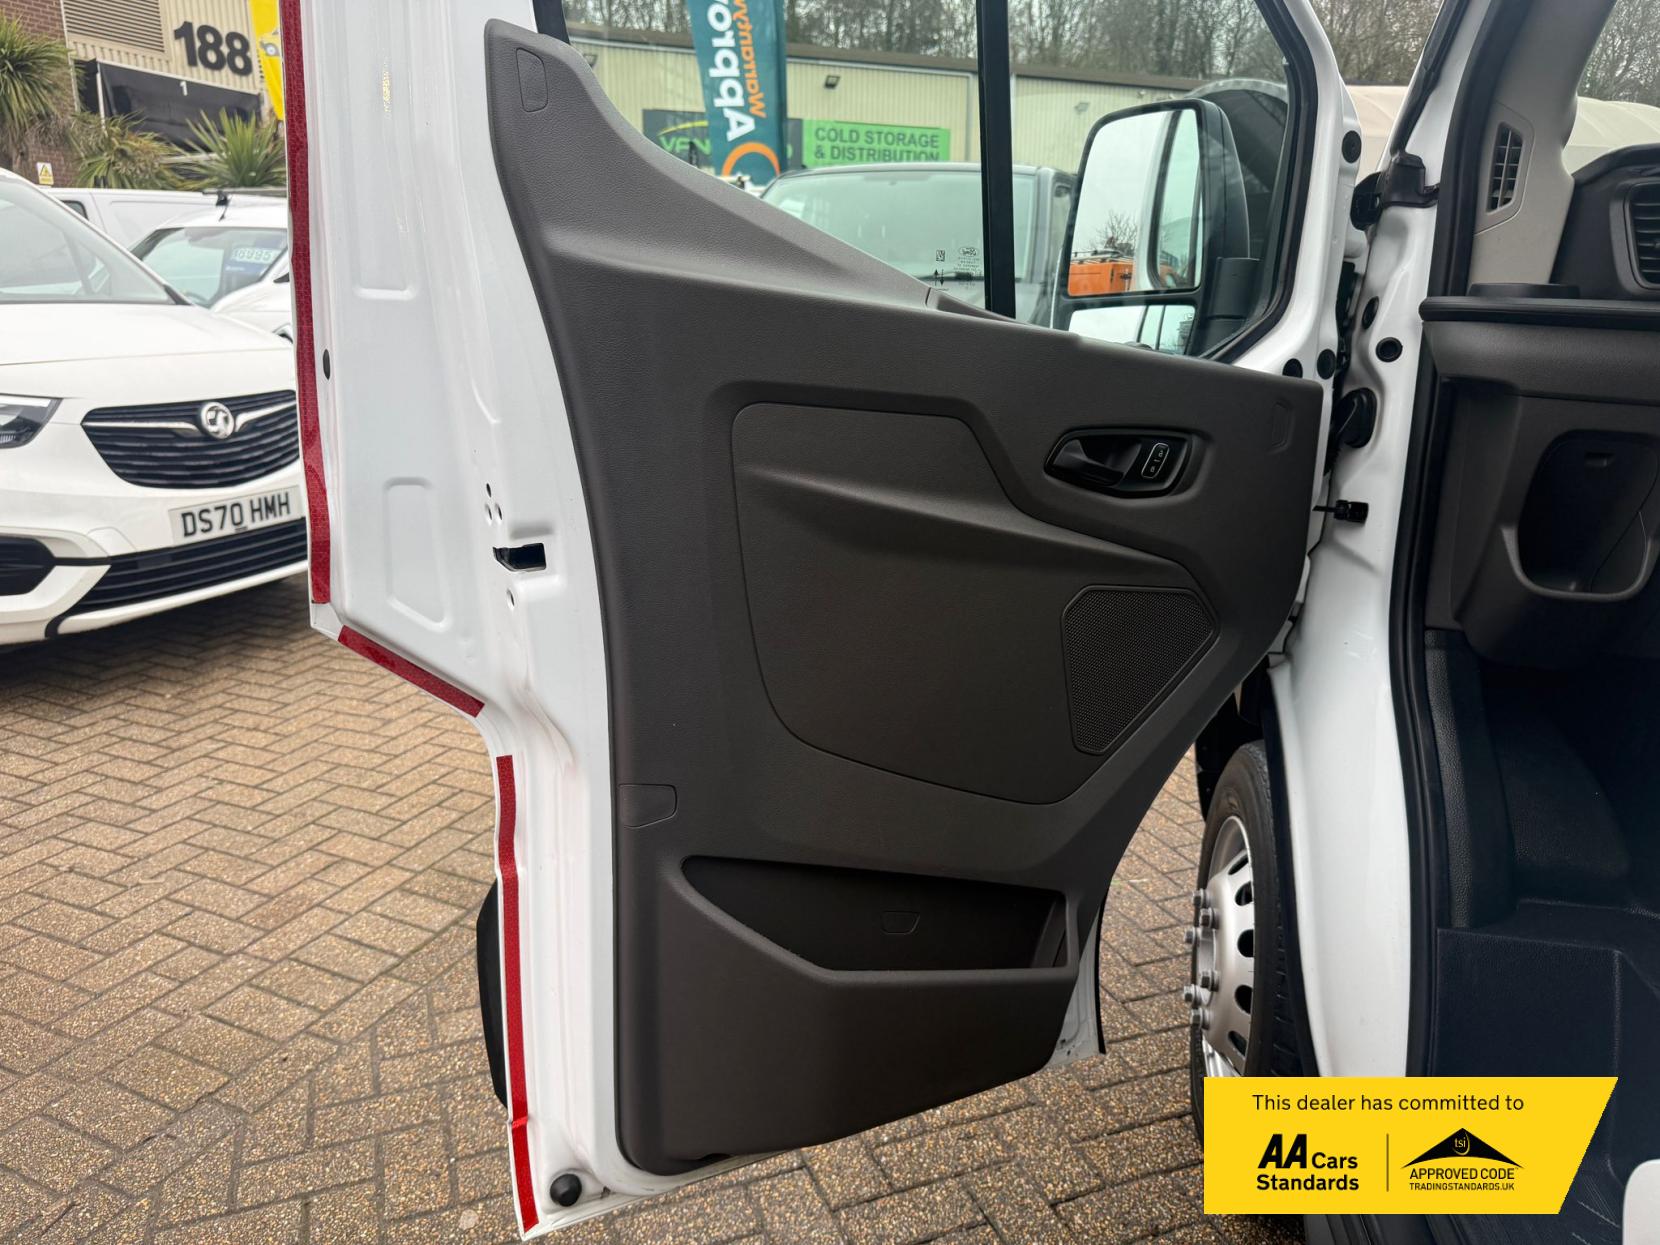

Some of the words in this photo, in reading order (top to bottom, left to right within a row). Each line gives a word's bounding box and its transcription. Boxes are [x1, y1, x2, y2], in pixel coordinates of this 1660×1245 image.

[174, 21, 253, 76] 188
[814, 127, 860, 144] COLD
[862, 129, 940, 149] STORAGE
[814, 145, 826, 160] &
[830, 145, 940, 162] DISTRIBUTION
[182, 503, 243, 537] DS70
[250, 491, 291, 523] HMH
